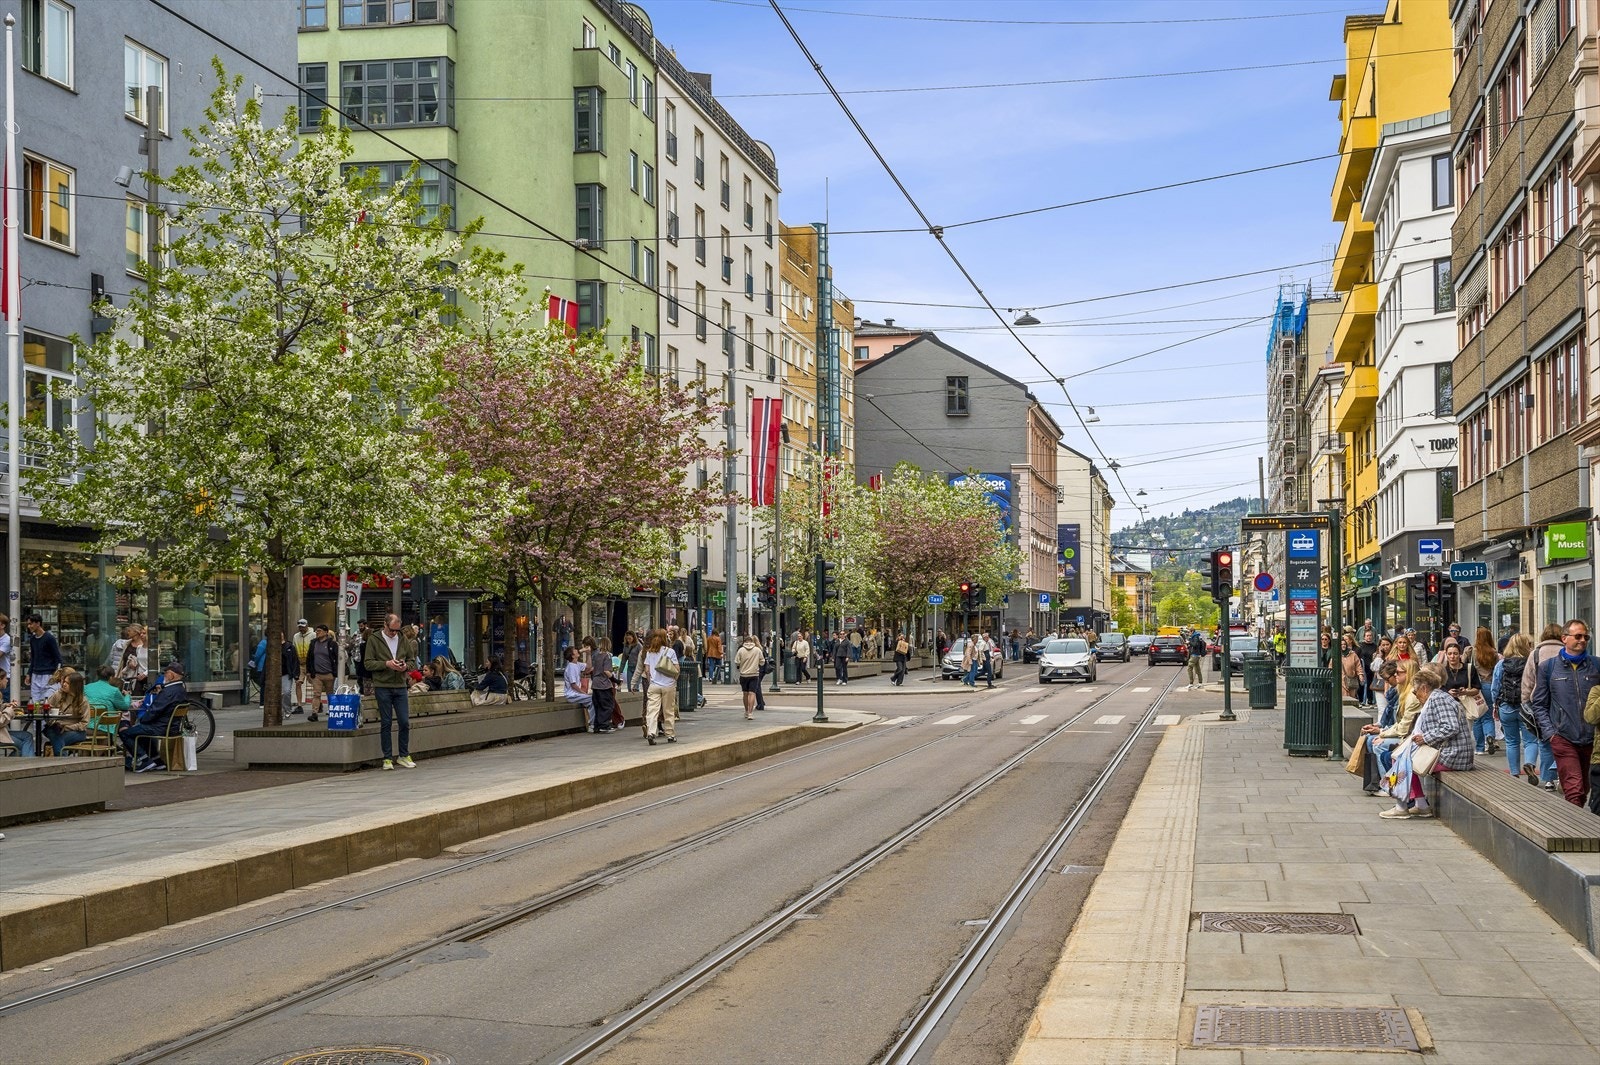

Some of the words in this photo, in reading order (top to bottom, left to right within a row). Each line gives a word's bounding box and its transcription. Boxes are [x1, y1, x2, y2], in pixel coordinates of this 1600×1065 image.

[1557, 540, 1585, 549] Musti
[1454, 566, 1484, 577] norli
[1041, 594, 1048, 603] P
